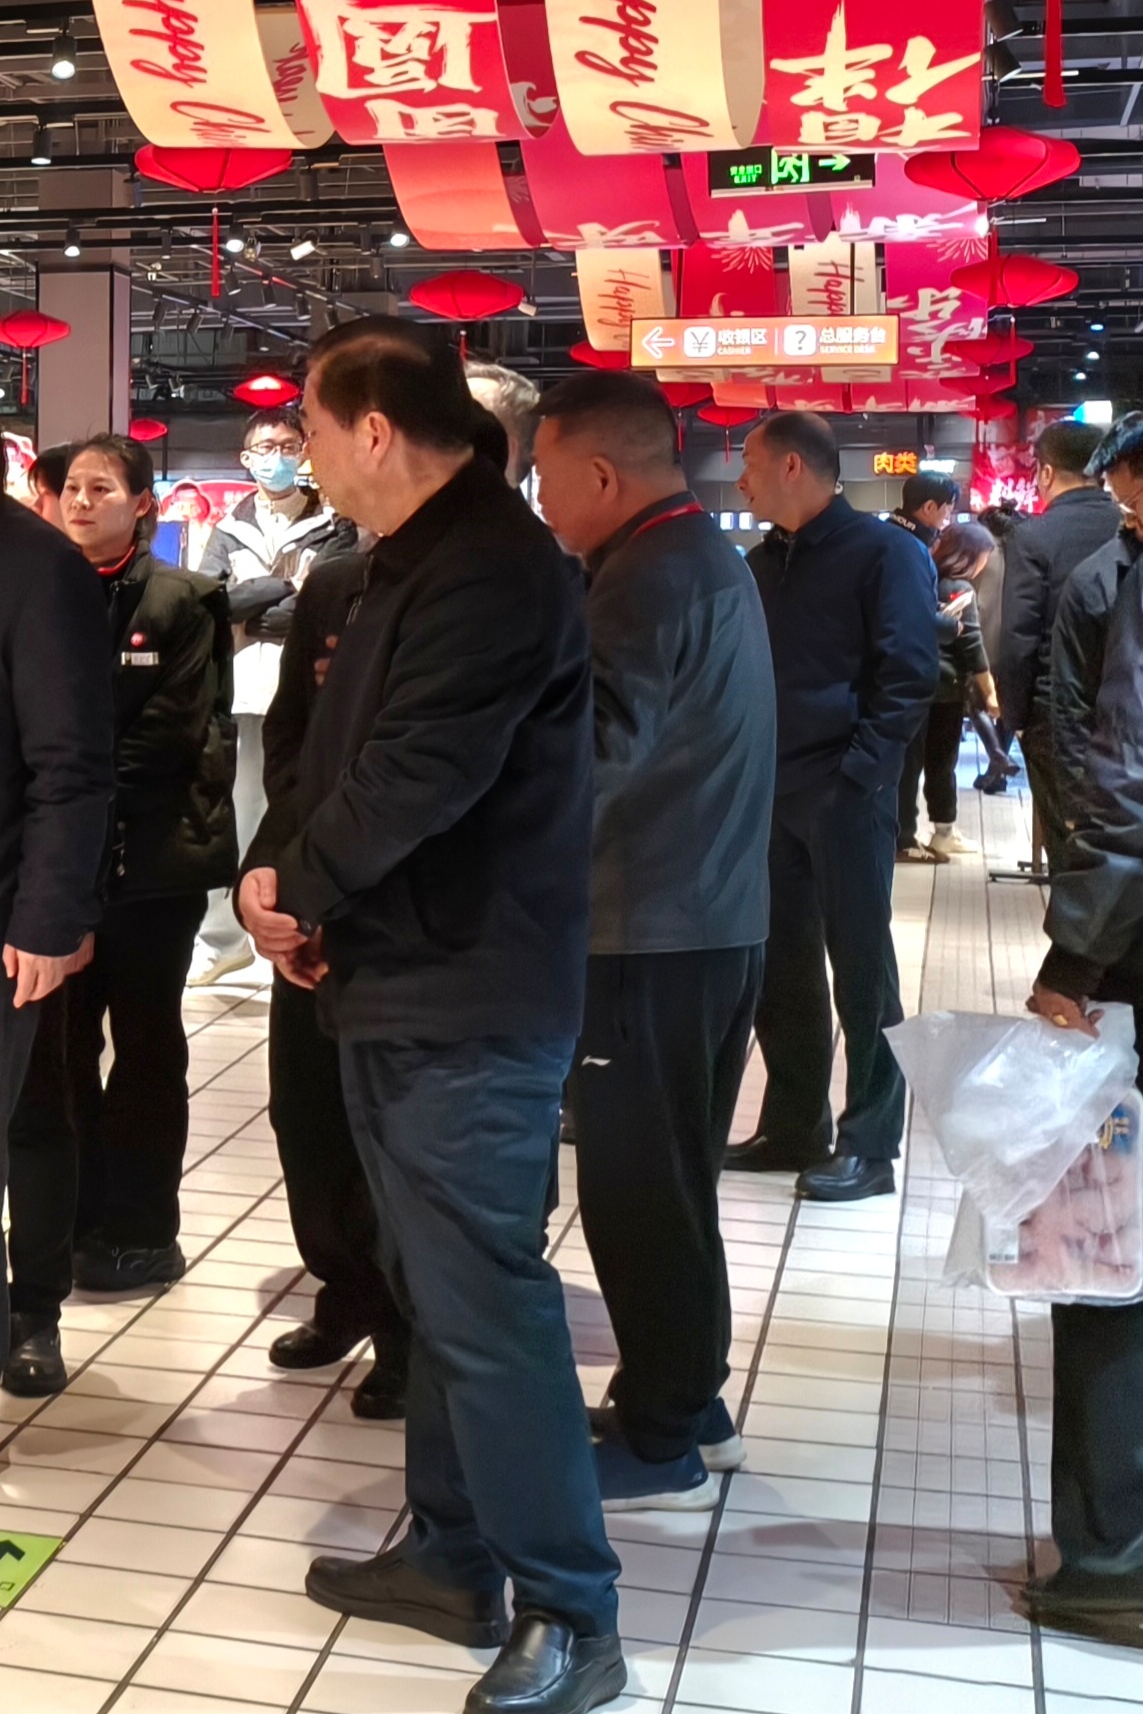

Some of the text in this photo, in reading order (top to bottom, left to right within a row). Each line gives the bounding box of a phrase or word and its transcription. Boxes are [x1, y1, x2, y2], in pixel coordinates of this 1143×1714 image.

[121, 0, 208, 88] ppy
[574, 0, 659, 88] ppy
[718, 327, 768, 345] 收银区
[819, 326, 887, 344] 总服务台
[873, 451, 918, 475] 肉类
